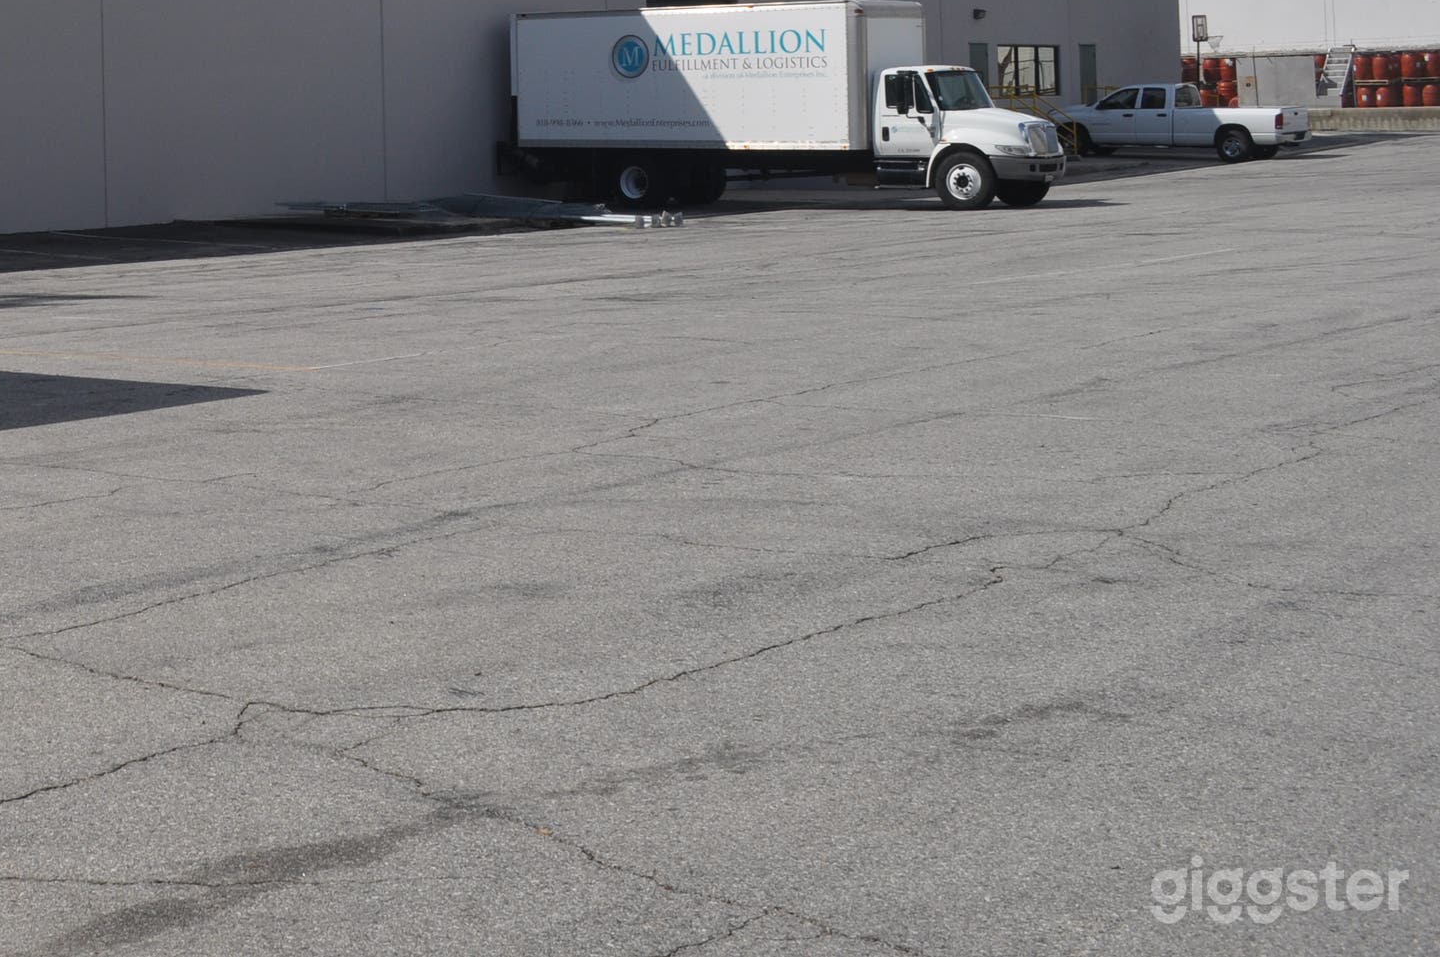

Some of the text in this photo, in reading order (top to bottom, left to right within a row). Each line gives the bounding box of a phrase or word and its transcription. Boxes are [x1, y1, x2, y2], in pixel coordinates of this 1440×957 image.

[652, 28, 826, 57] MEDALLION
[622, 45, 641, 67] M
[652, 55, 828, 73] FULFILLMENT & LOGISTICS
